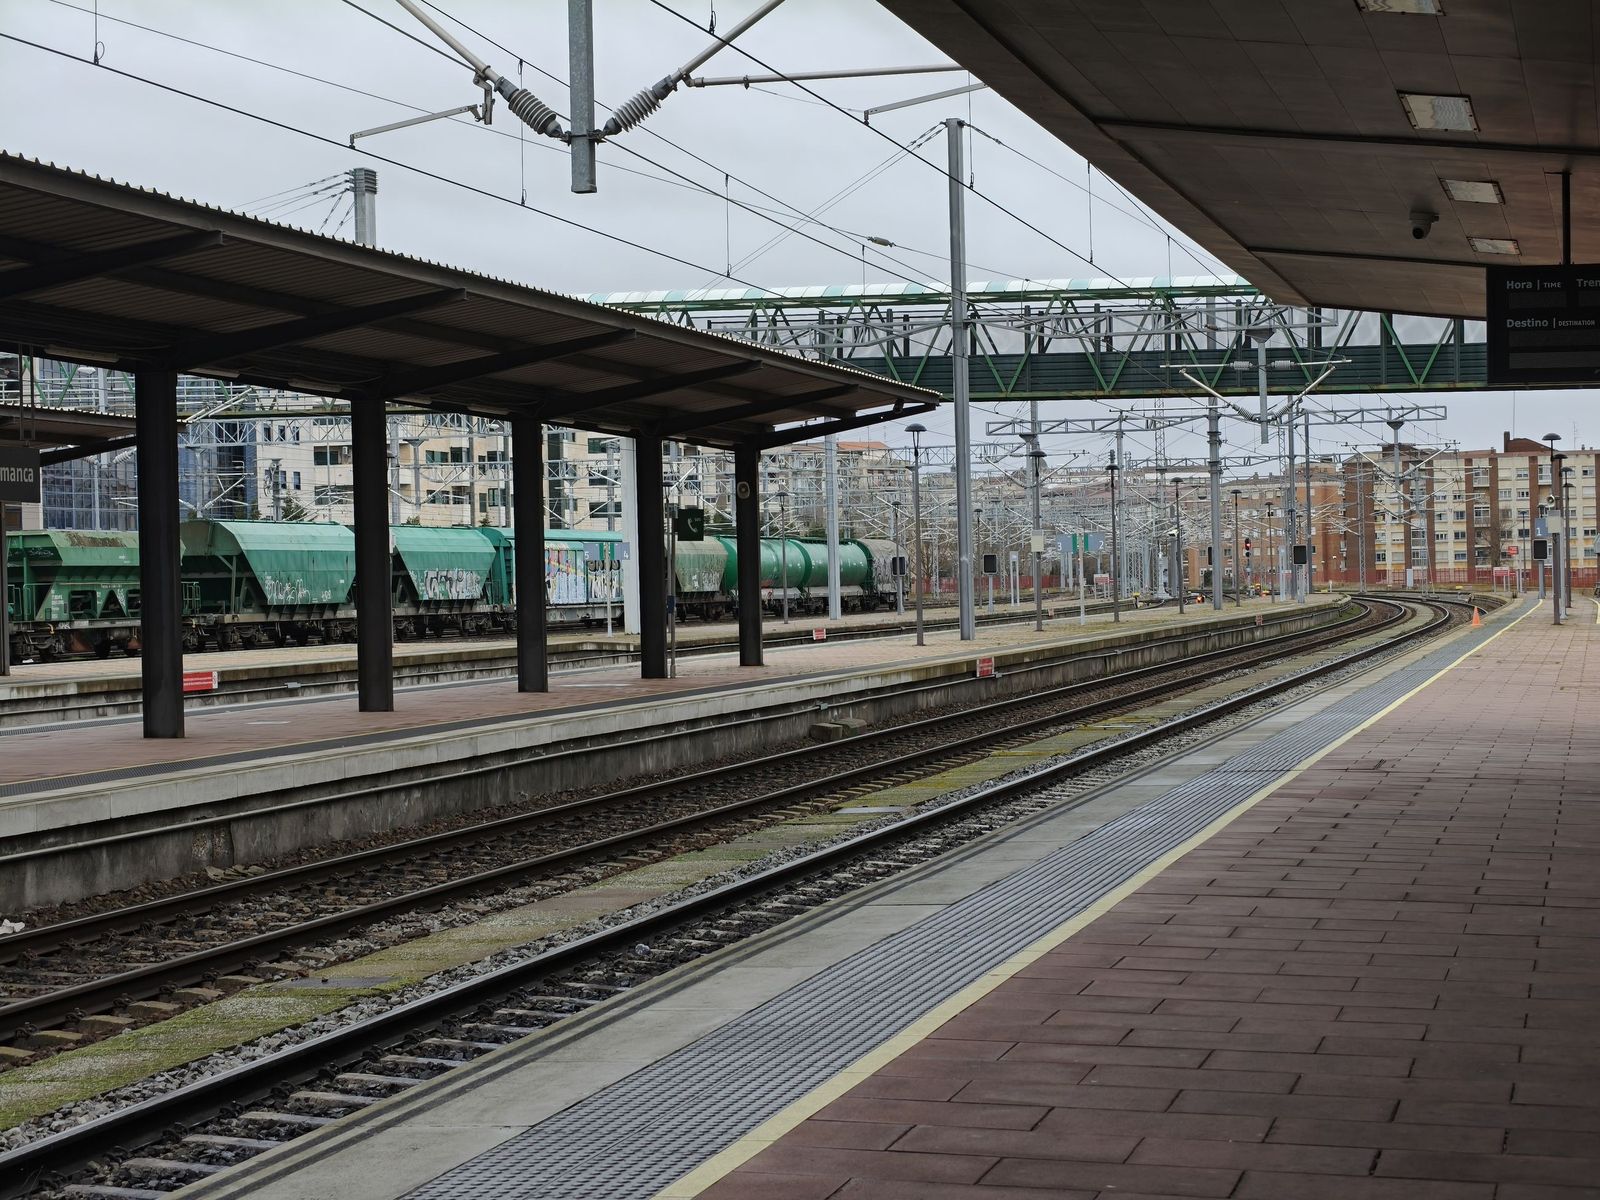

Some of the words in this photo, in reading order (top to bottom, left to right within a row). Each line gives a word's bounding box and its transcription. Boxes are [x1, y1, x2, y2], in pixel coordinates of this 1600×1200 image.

[1506, 280, 1533, 290] Hora
[1543, 281, 1562, 289] TIME
[1506, 318, 1549, 328] Destino
[1558, 319, 1596, 327] DESTINATION
[1057, 542, 1062, 551] 3
[1098, 540, 1104, 550] 2
[584, 551, 590, 560] 5
